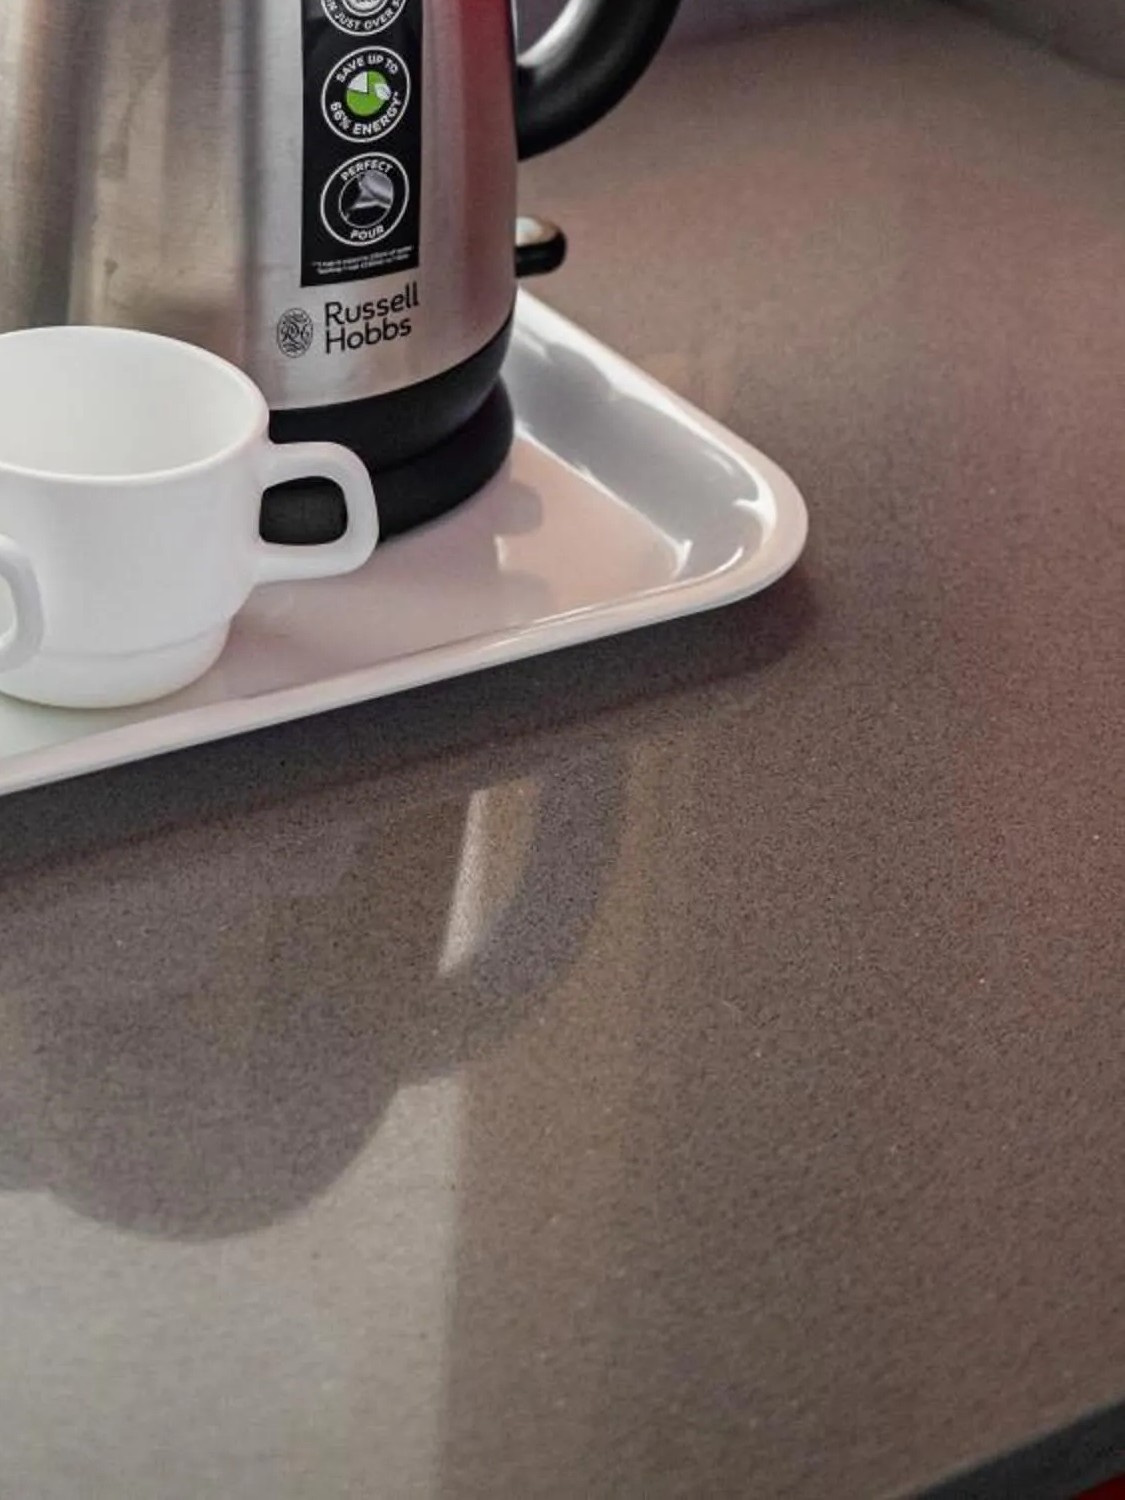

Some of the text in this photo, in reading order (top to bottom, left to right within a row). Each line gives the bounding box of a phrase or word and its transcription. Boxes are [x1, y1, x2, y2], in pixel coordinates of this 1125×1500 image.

[334, 11, 361, 30] JUST
[364, 7, 394, 30] OVER
[336, 54, 399, 83] SAVE UP TO
[340, 159, 394, 181] PERFECT
[350, 224, 385, 240] POUR
[325, 280, 420, 327] Russell
[325, 317, 412, 354] Hobbs
